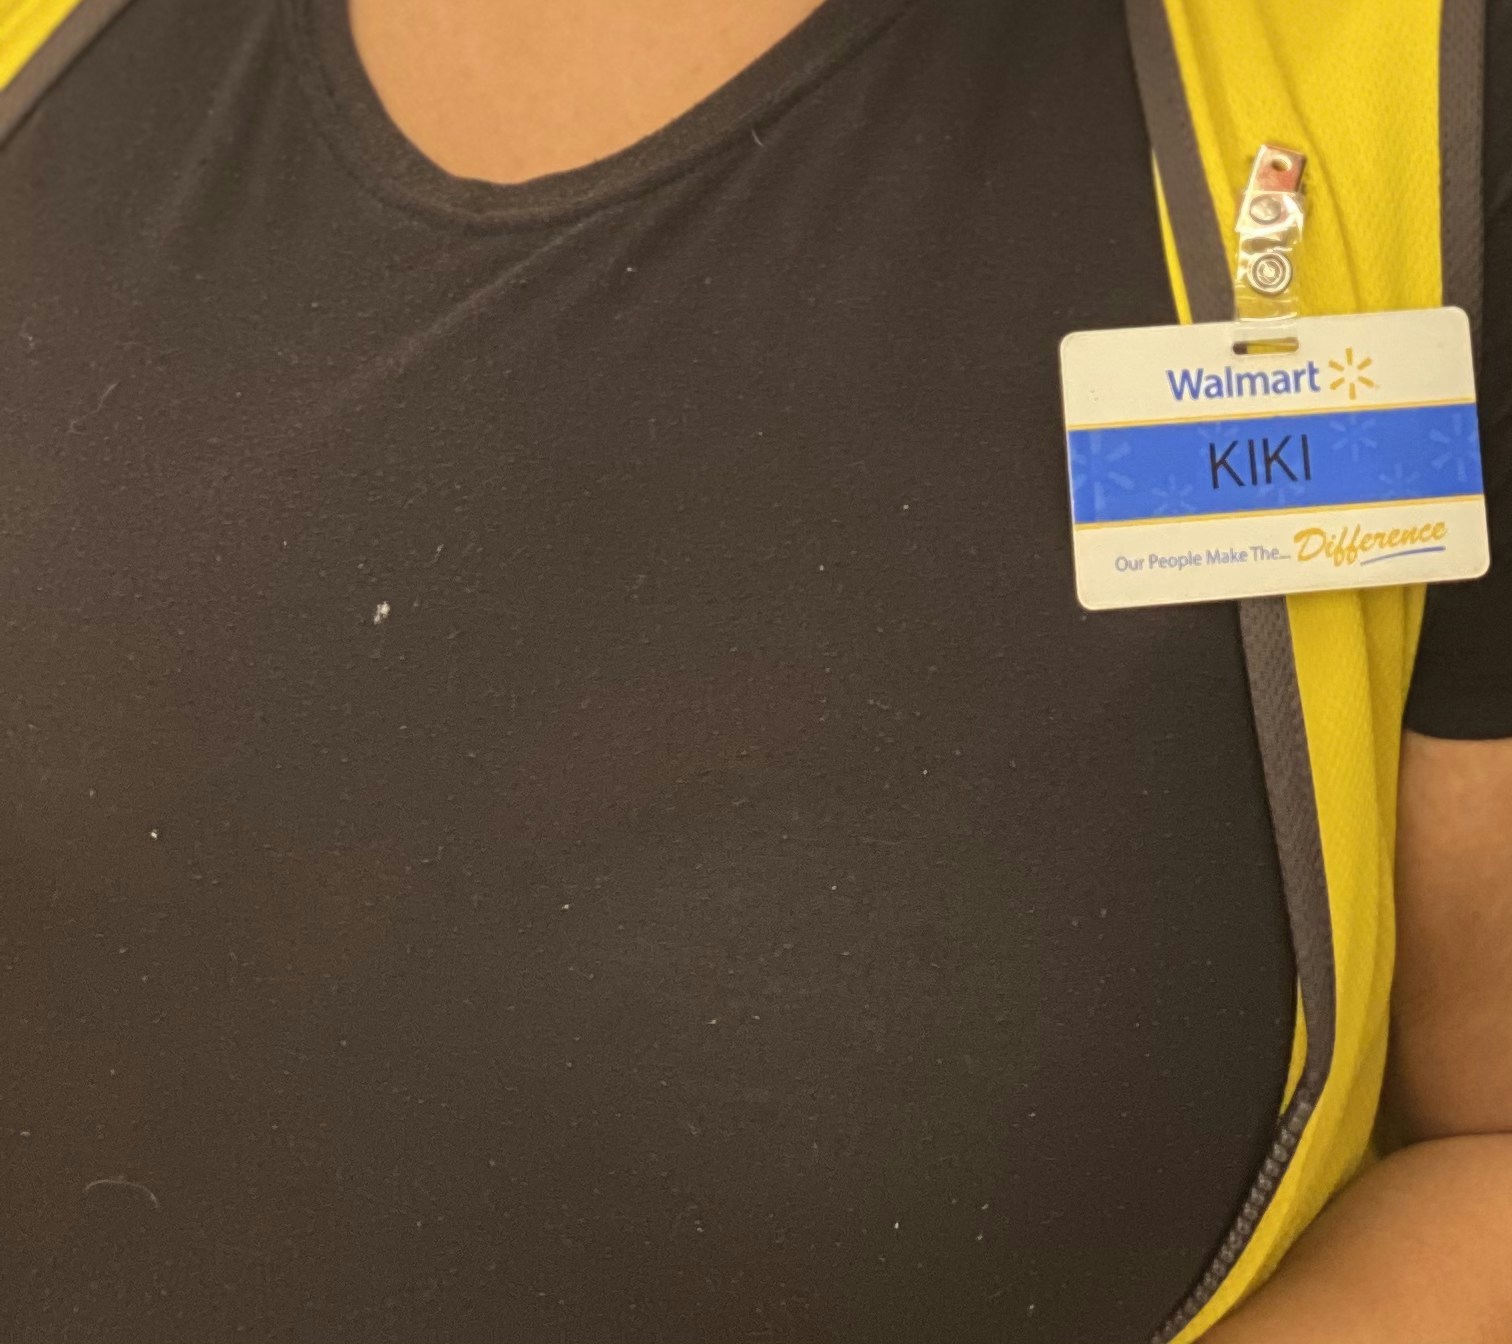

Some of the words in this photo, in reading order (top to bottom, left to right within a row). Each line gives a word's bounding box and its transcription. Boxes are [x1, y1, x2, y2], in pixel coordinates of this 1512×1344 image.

[1165, 361, 1321, 402] Walmart
[1209, 433, 1312, 490] KIKI
[1114, 553, 1145, 572] Our
[1148, 549, 1203, 572] People
[1206, 545, 1248, 566] Make
[1293, 520, 1447, 568] Difference
